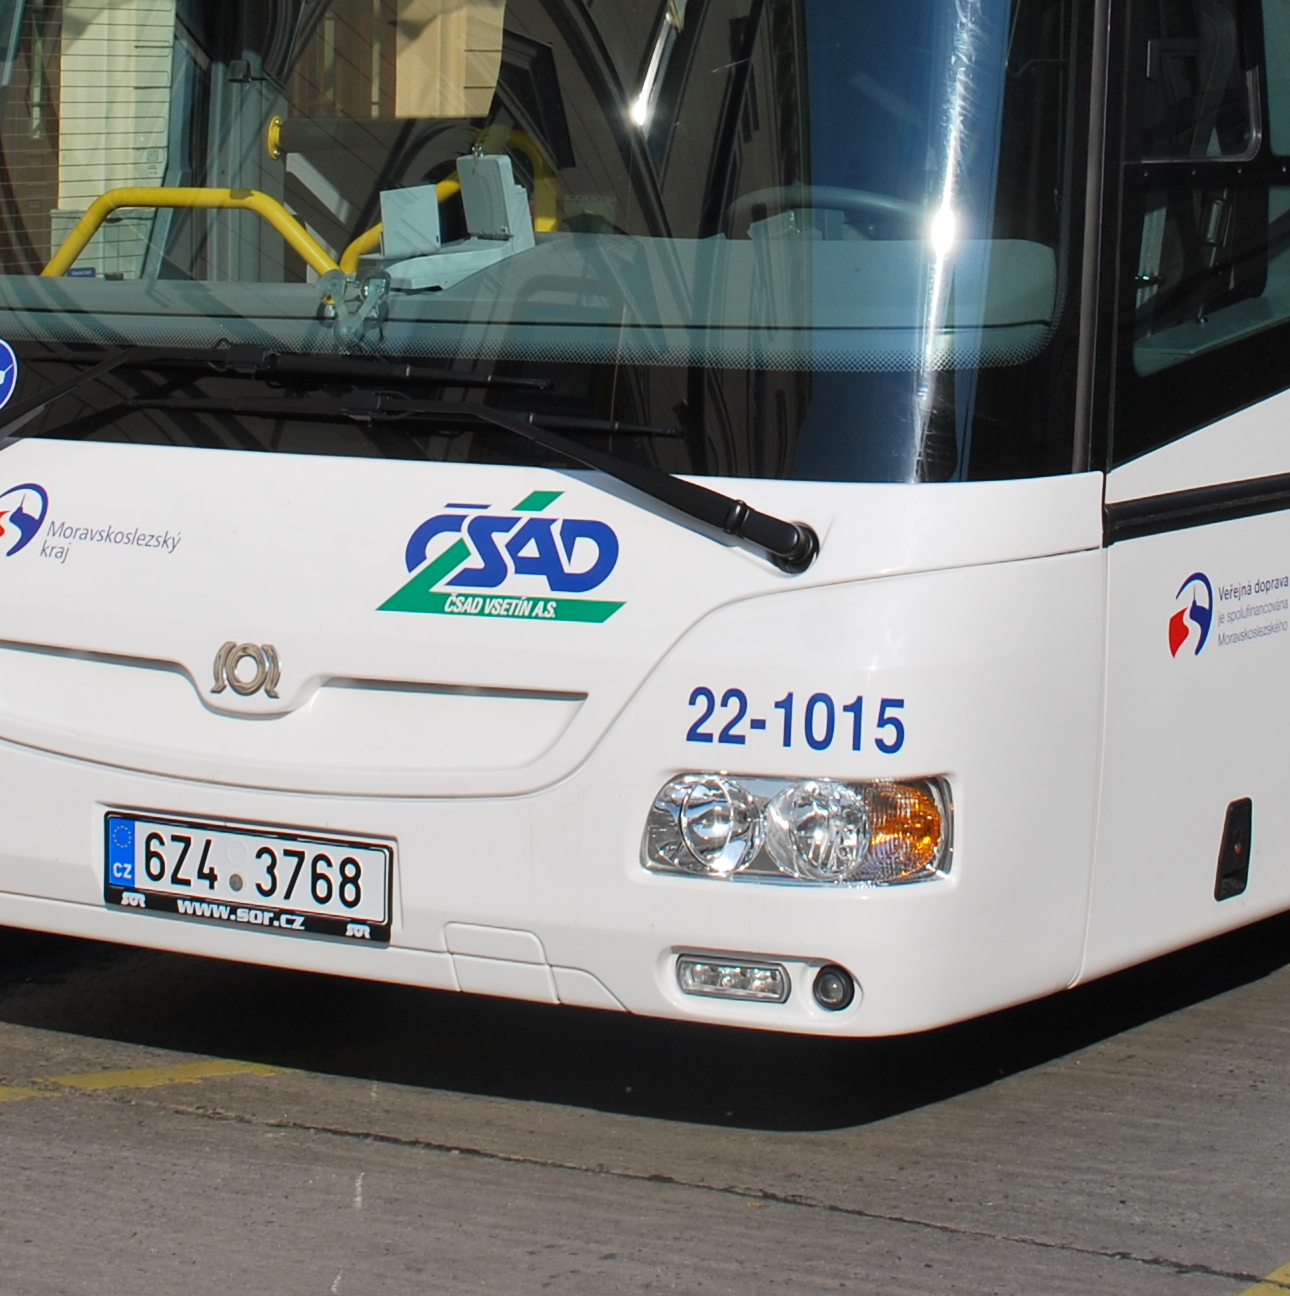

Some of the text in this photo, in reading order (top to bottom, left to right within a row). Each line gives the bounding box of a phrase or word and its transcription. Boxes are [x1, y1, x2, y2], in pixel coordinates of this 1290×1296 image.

[46, 520, 182, 554] Moravskoslezský
[39, 539, 72, 565] kraj
[1218, 576, 1289, 601] Veřejná doprava
[444, 592, 557, 618] ČSAD VSETÍN A.S.
[1217, 611, 1225, 627] je
[1227, 597, 1289, 623] spolufinancovaná
[1217, 618, 1289, 646] Moravskoslezského
[686, 686, 905, 754] 22-1015
[112, 862, 133, 880] CZ
[144, 831, 362, 908] 6Z4 3768
[177, 899, 306, 931] www.sor.cz
